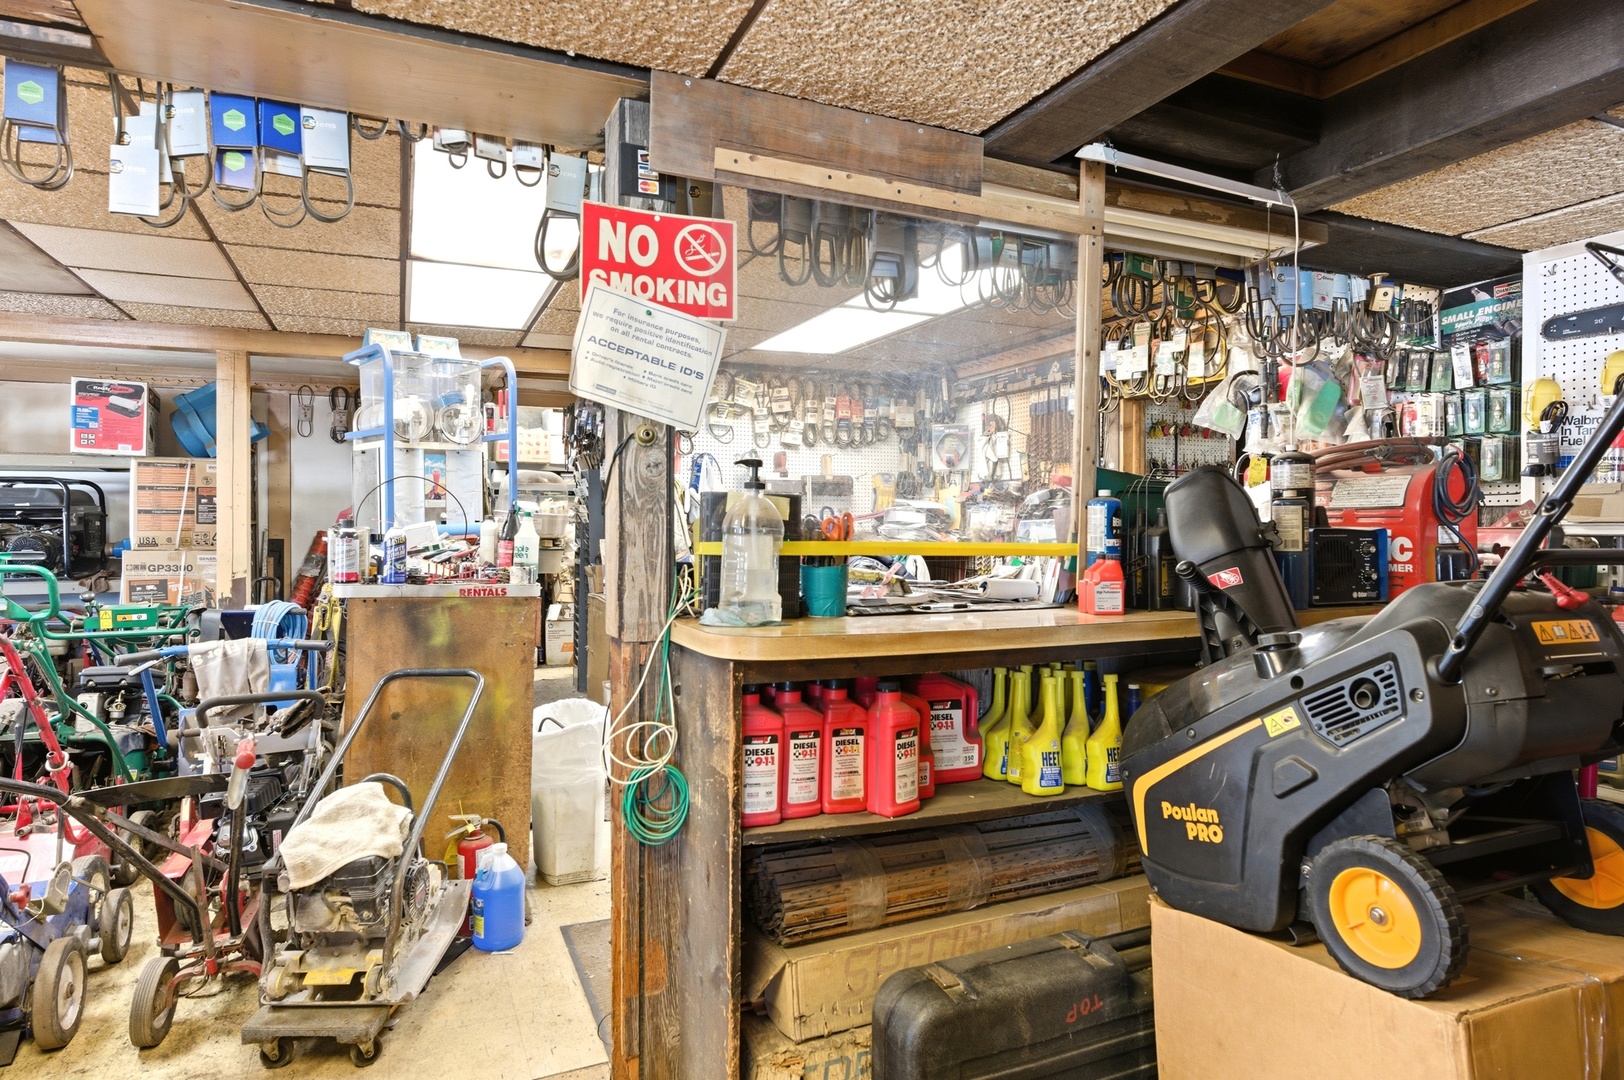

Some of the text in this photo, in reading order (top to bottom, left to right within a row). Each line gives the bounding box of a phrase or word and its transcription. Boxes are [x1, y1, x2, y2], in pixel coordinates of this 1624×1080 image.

[309, 119, 337, 129] Stens
[598, 218, 659, 267] NO
[589, 268, 727, 307] SMOKING
[1440, 299, 1523, 325] SMALL ENGINE
[592, 311, 713, 357] we require positive identification
[613, 308, 701, 344] For insurance purposes,
[621, 328, 630, 337] all
[632, 333, 654, 346] rental
[656, 342, 693, 359] contracts.
[587, 335, 705, 380] ACCEPTABLE ID'S
[1562, 415, 1603, 426] Walbro
[1561, 426, 1597, 436] In Tan
[1561, 436, 1585, 446] Fuel
[459, 588, 507, 597] RENTALS
[793, 742, 817, 750] DIESEL
[835, 739, 860, 747] DIESEL
[897, 740, 916, 750] DIESEL
[745, 748, 775, 756] DIESEL
[1041, 751, 1060, 767] HEET
[1106, 747, 1120, 762] HEE
[1161, 801, 1219, 824] Poulan
[1186, 822, 1223, 844] PRO
[1065, 994, 1104, 1023] TOP
